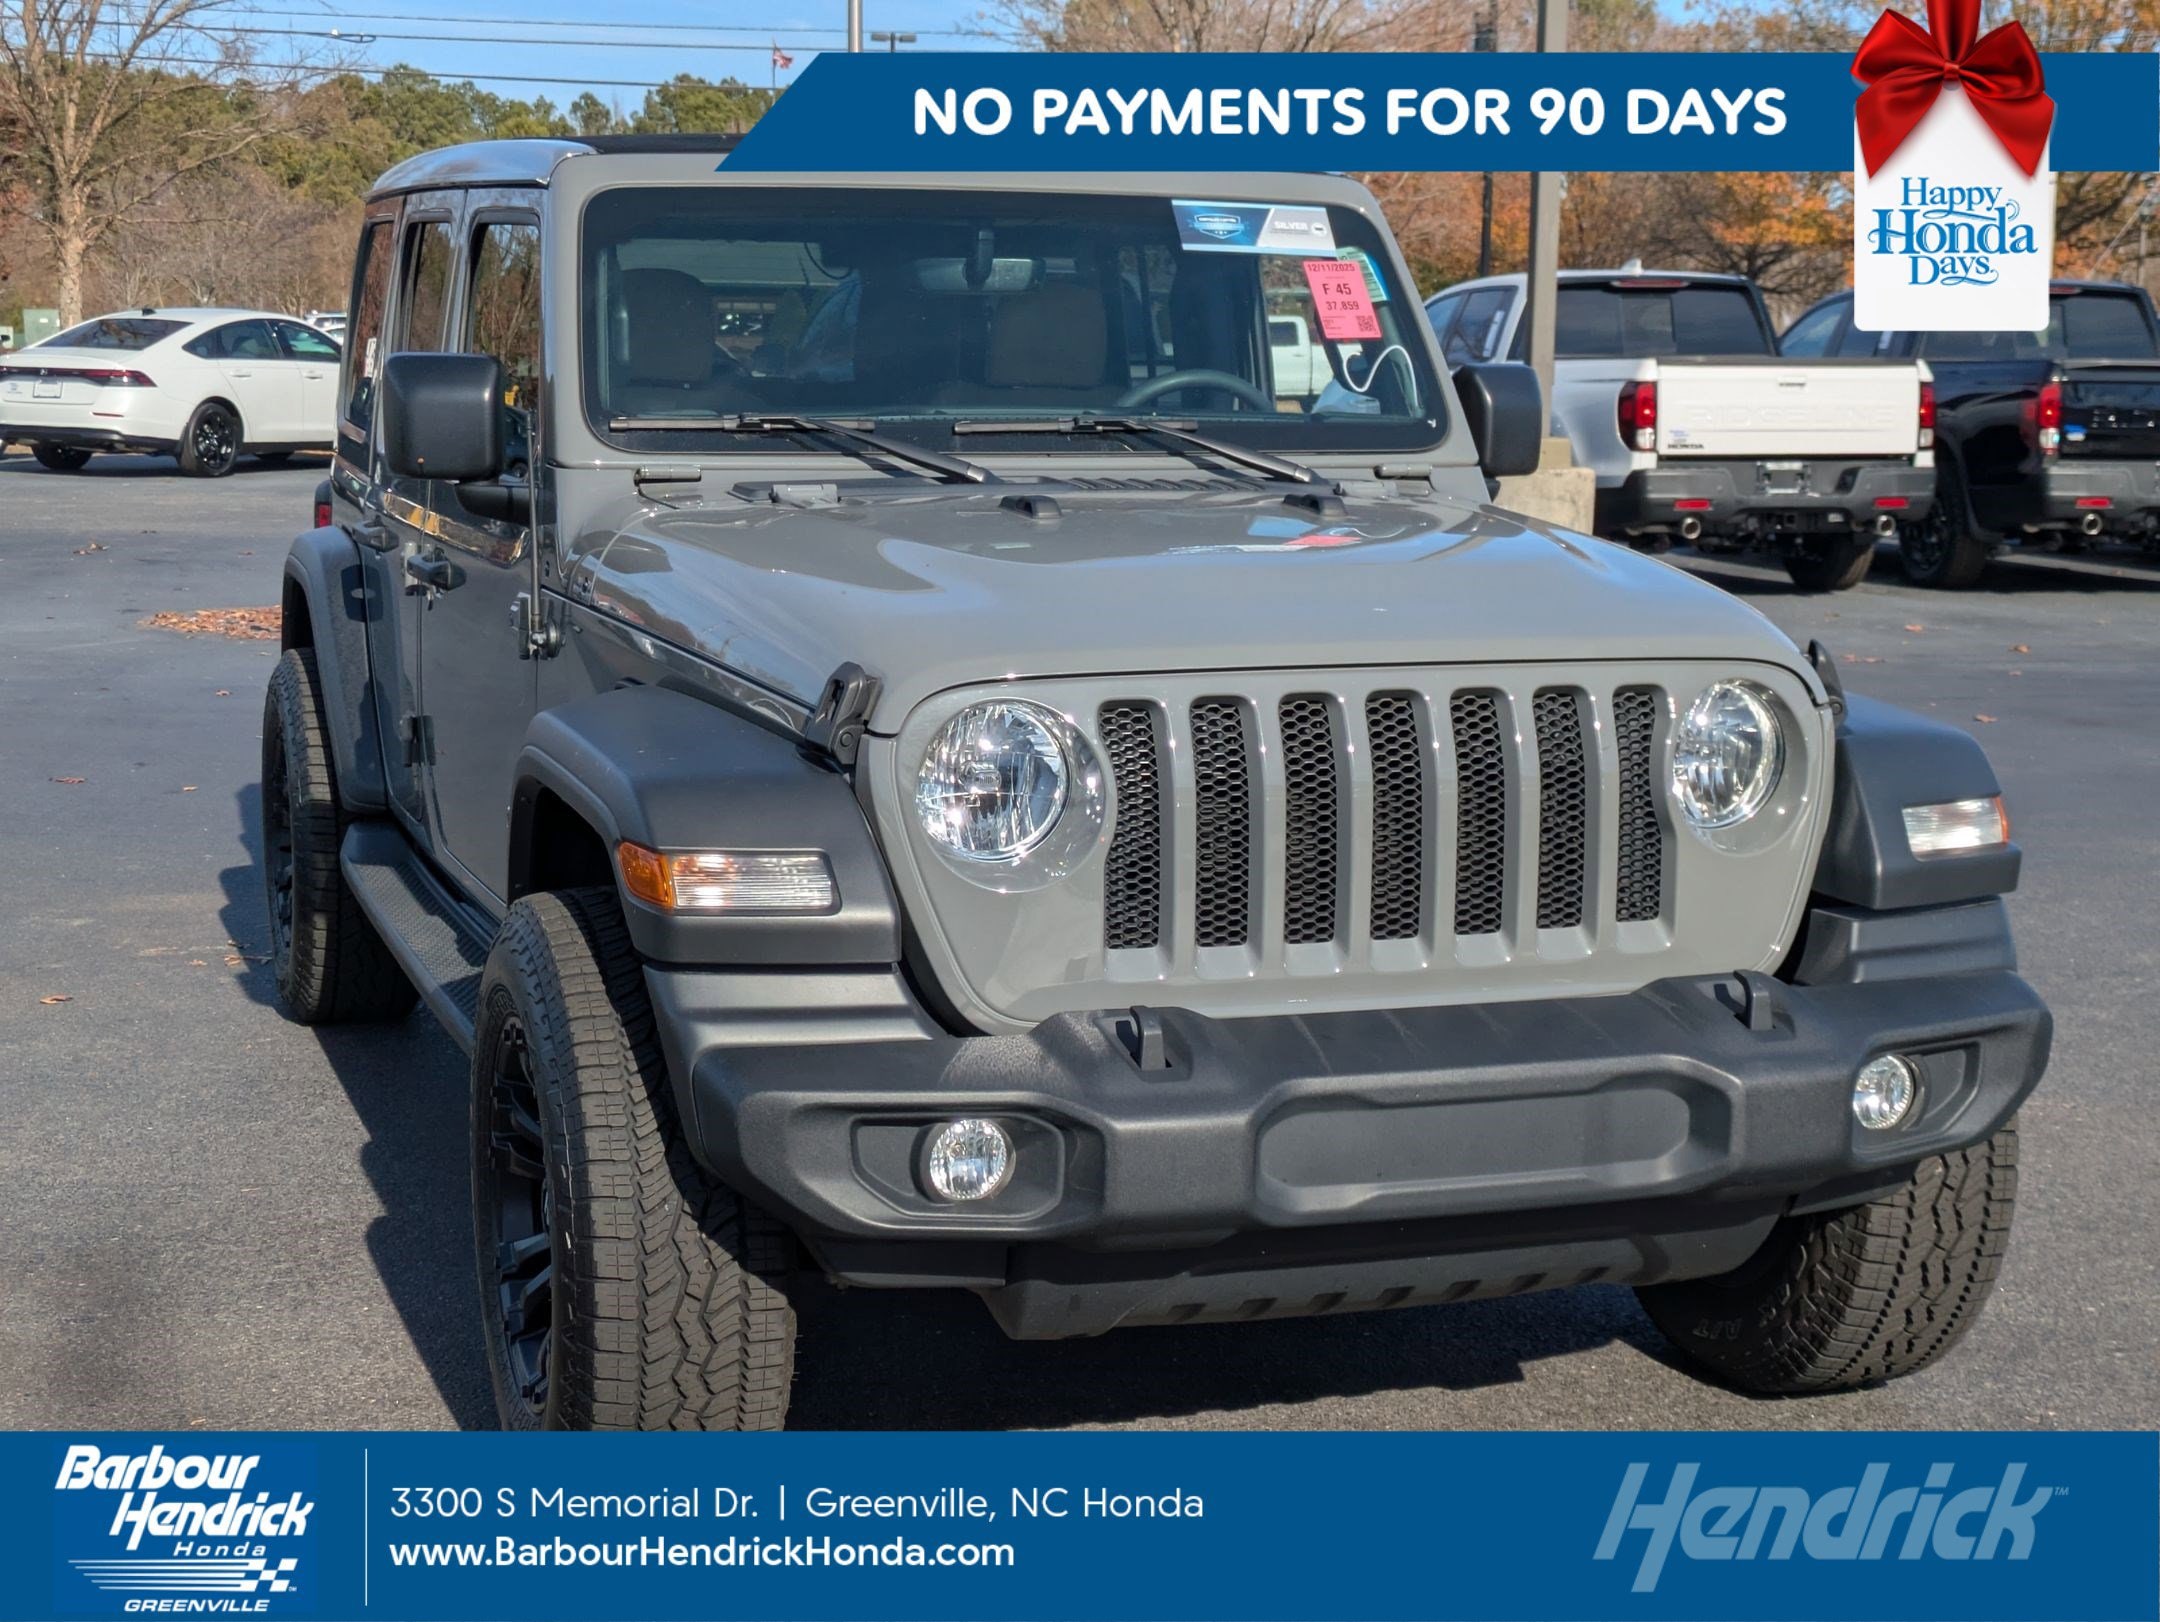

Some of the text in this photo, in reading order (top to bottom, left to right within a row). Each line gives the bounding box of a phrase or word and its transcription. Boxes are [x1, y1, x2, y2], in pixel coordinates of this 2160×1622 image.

[1307, 263, 1356, 272] 12/11/2025
[1322, 283, 1352, 295] F 45
